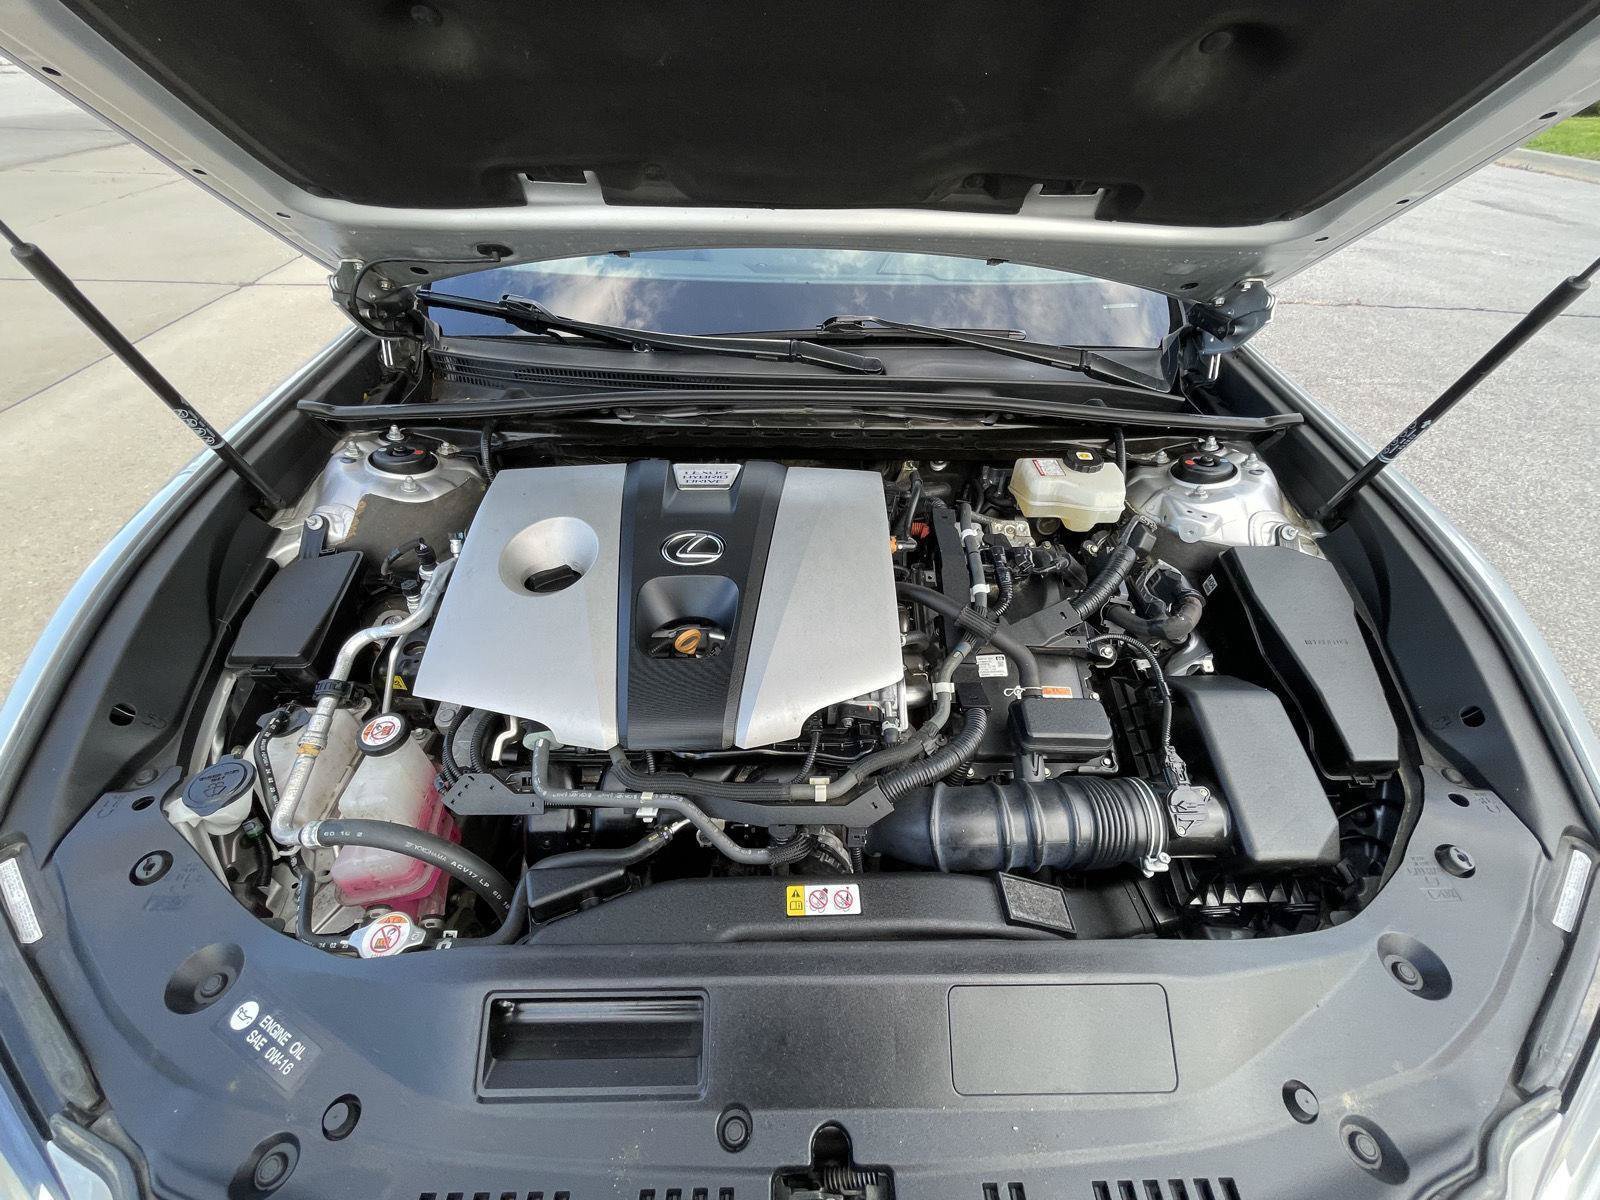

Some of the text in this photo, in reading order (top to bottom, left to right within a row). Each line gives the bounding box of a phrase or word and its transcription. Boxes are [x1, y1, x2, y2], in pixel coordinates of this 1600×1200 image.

[450, 861, 478, 878] ACV17
[479, 878, 490, 888] LP
[246, 1029, 294, 1075] SAE 0W-16
[259, 1014, 306, 1061] ENGINE OIL
